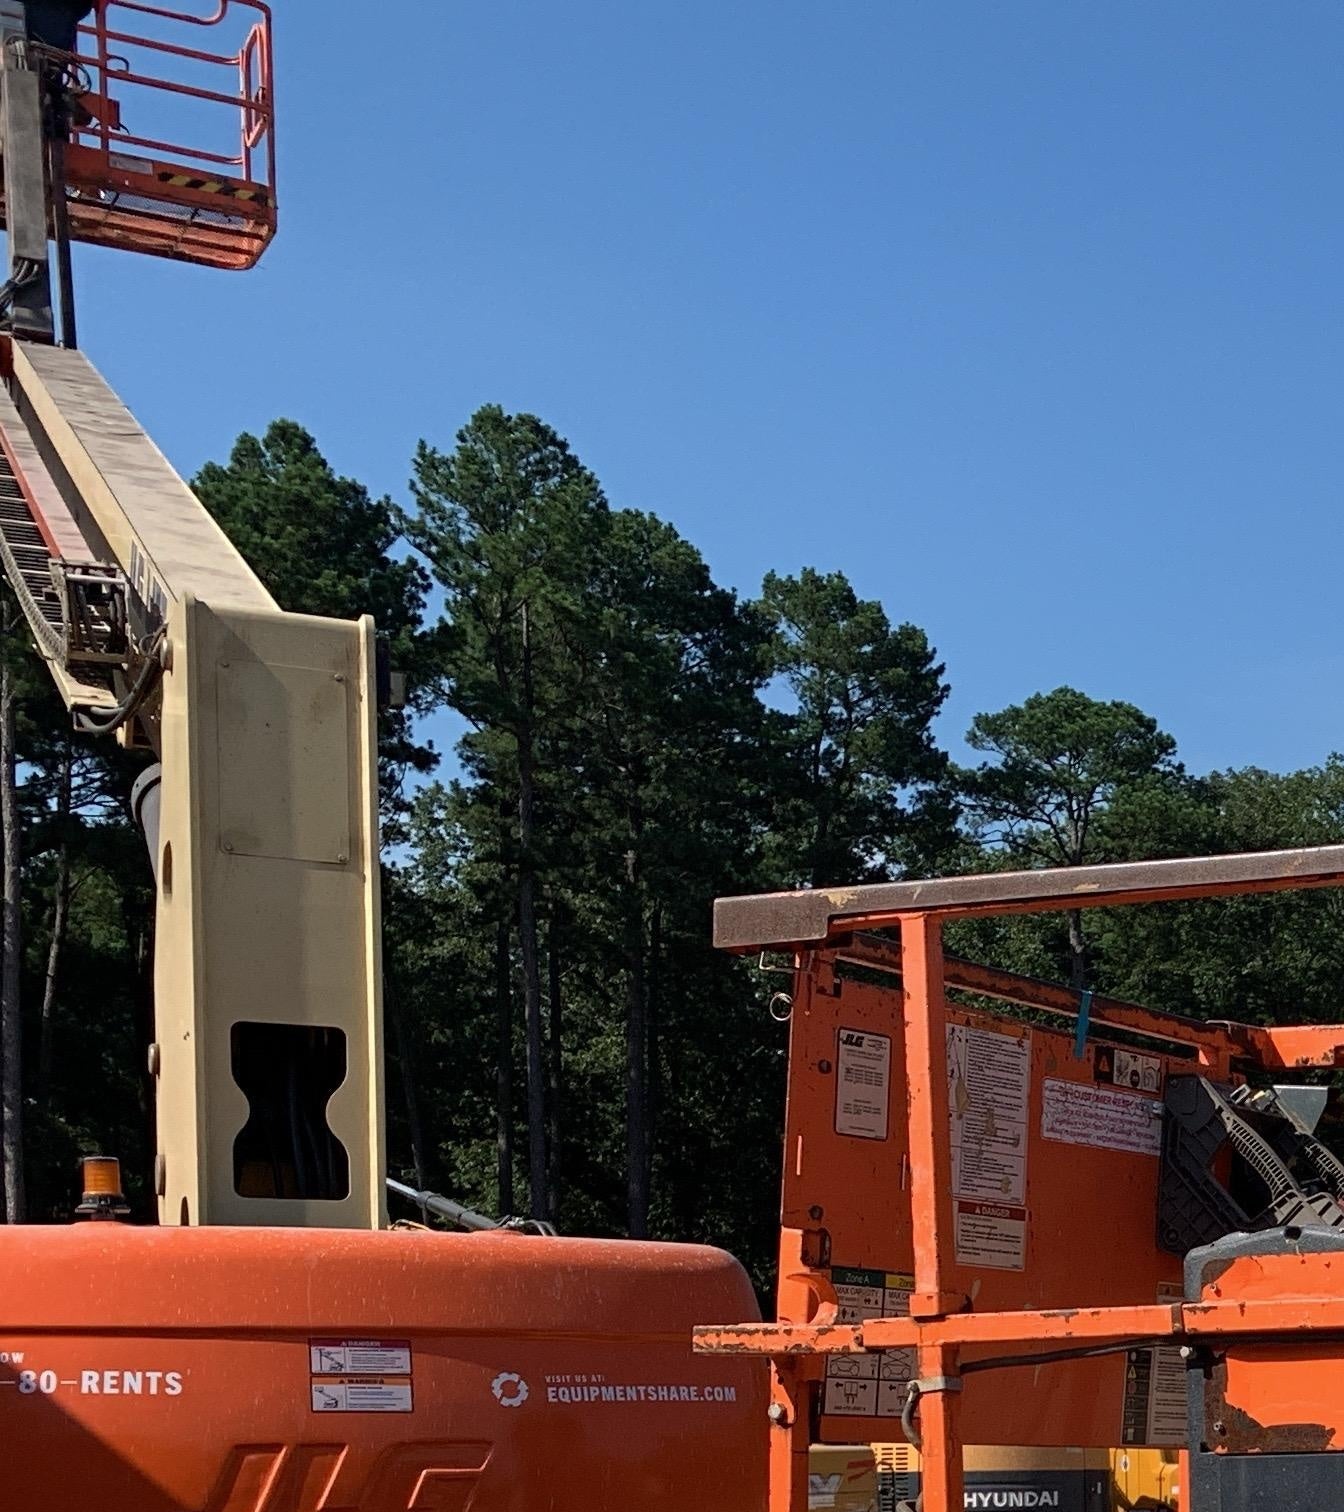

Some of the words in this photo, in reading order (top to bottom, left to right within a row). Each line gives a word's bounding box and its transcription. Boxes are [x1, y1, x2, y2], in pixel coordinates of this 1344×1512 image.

[981, 1206, 1010, 1218] DANGER
[846, 1272, 863, 1283] Zone
[545, 1375, 571, 1383] VISIT
[575, 1375, 587, 1383] US
[548, 1385, 736, 1403] EQUIPMENTSHARE.COM
[963, 1490, 1059, 1508] HYUNDAI
